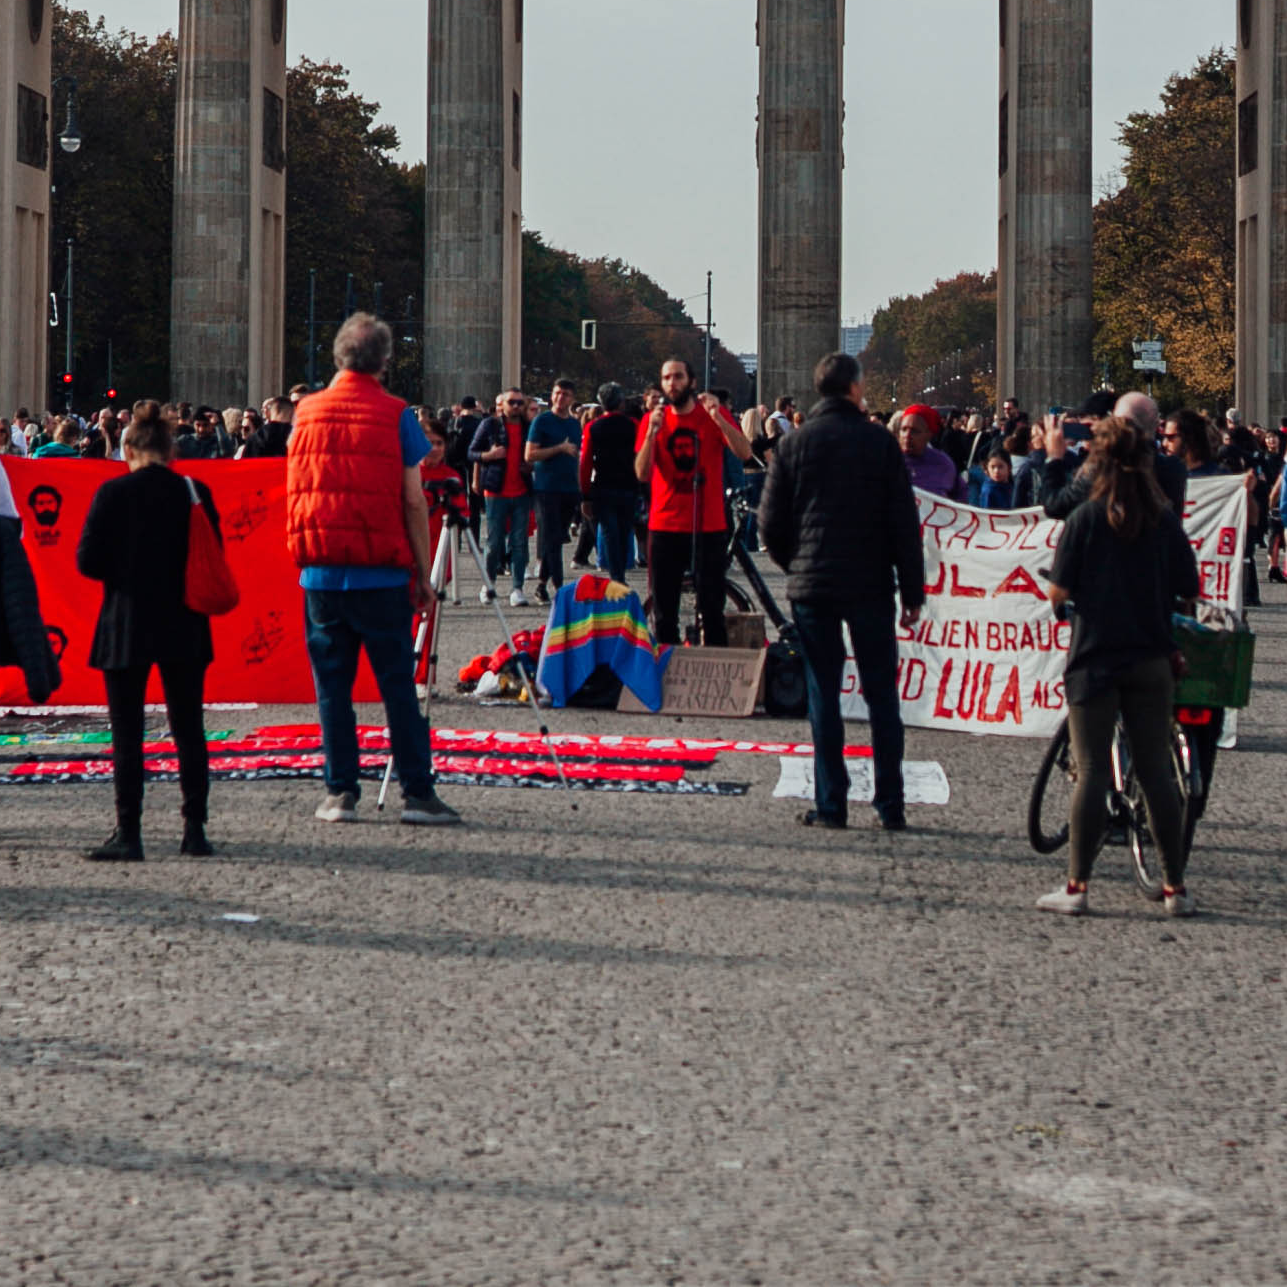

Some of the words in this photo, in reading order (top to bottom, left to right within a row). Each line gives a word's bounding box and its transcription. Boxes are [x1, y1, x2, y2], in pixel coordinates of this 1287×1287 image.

[896, 619, 979, 649] SILIEN
[986, 619, 1071, 652] BRAUC
[933, 657, 1023, 725] LULA
